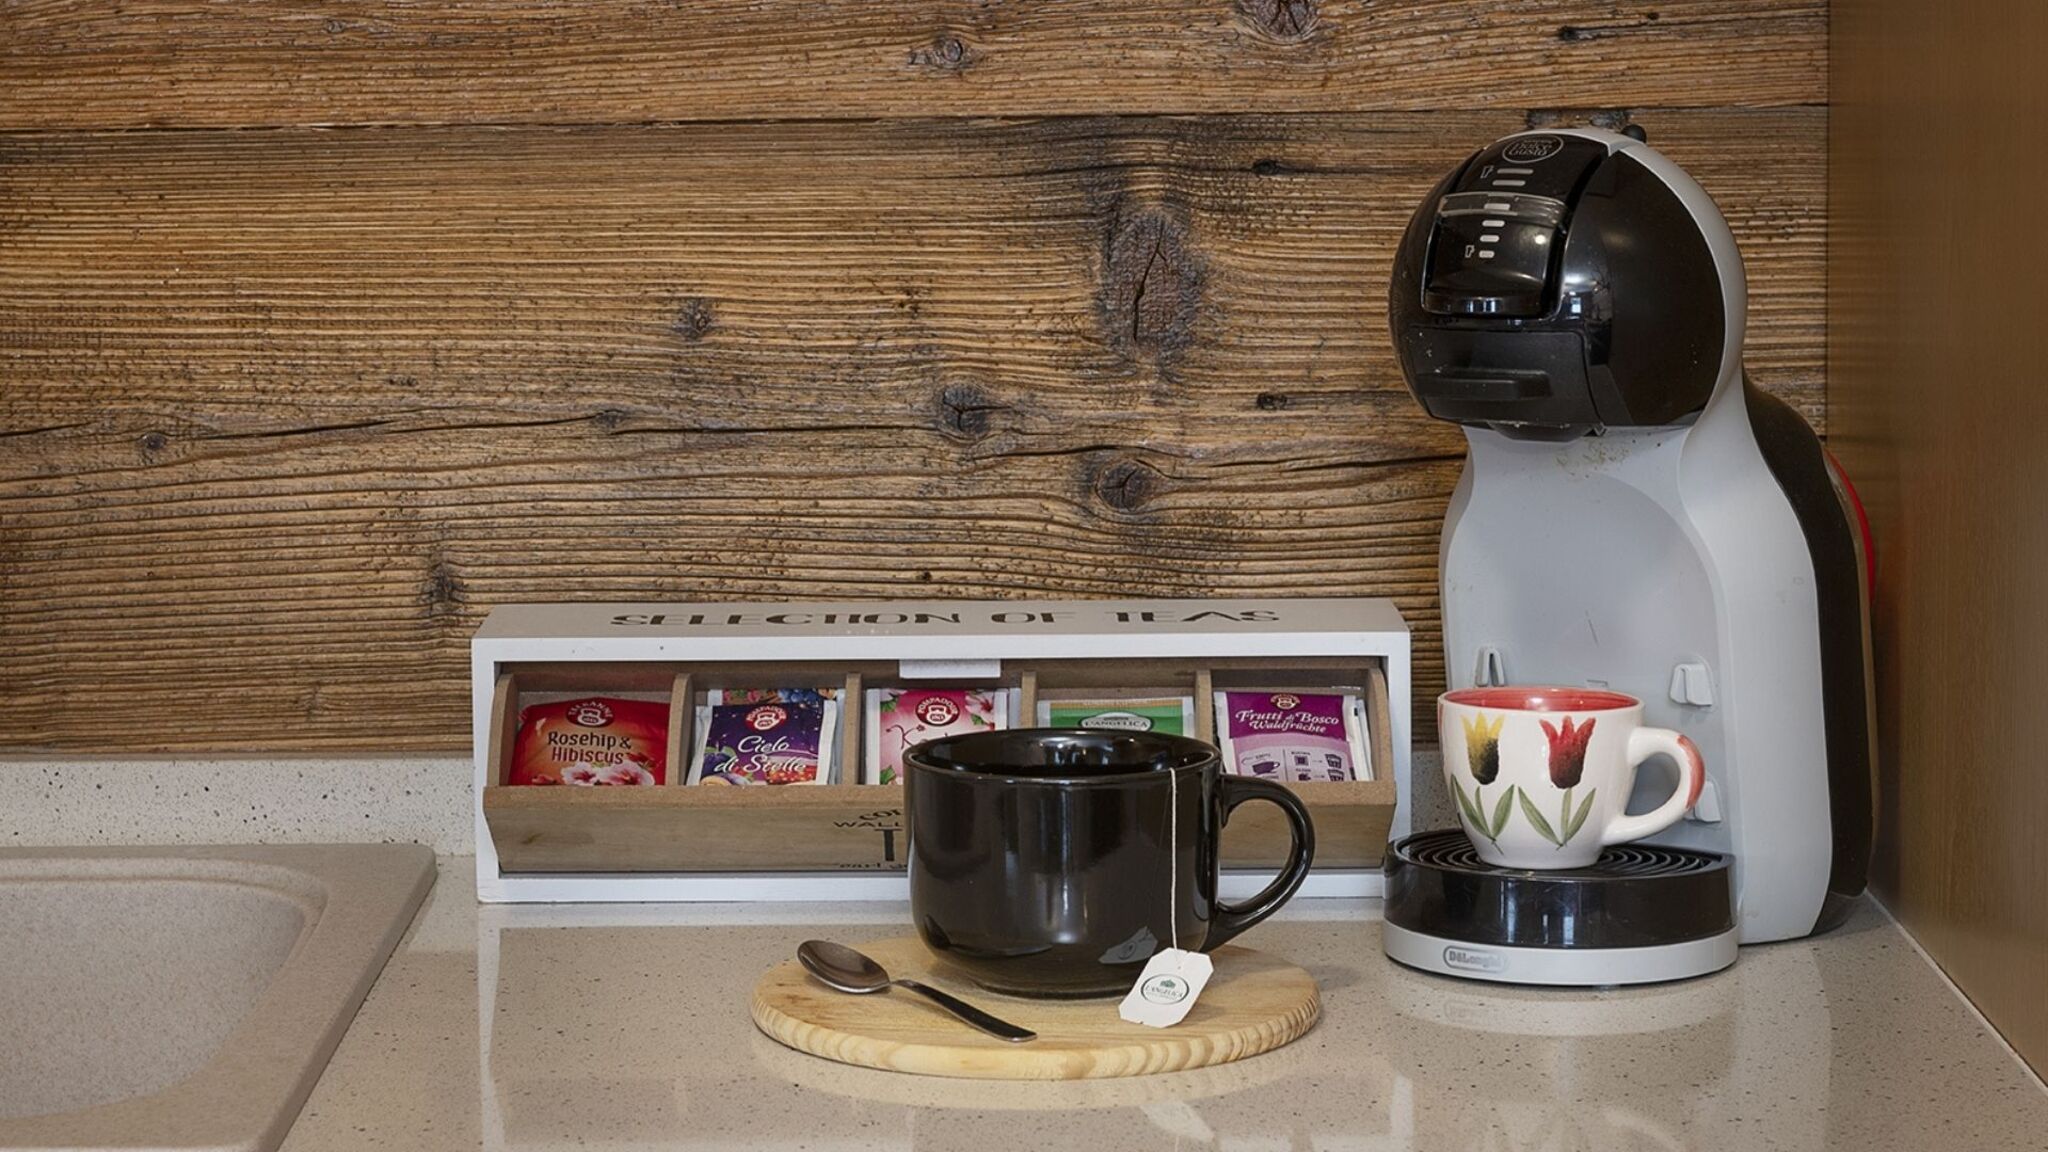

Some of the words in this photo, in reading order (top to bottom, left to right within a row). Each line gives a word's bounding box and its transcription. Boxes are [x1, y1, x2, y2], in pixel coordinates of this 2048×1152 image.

[610, 613, 962, 625] SELECTION
[991, 612, 1075, 623] OF
[1105, 609, 1280, 622] TEAS
[1235, 709, 1283, 724] Frutti
[1295, 711, 1340, 726] Bosco
[548, 730, 617, 751] Rosehip
[619, 736, 632, 750] &
[738, 735, 790, 753] Cielo
[552, 746, 624, 765] Hibiscus
[713, 756, 739, 773] di
[743, 753, 806, 773] Stelle
